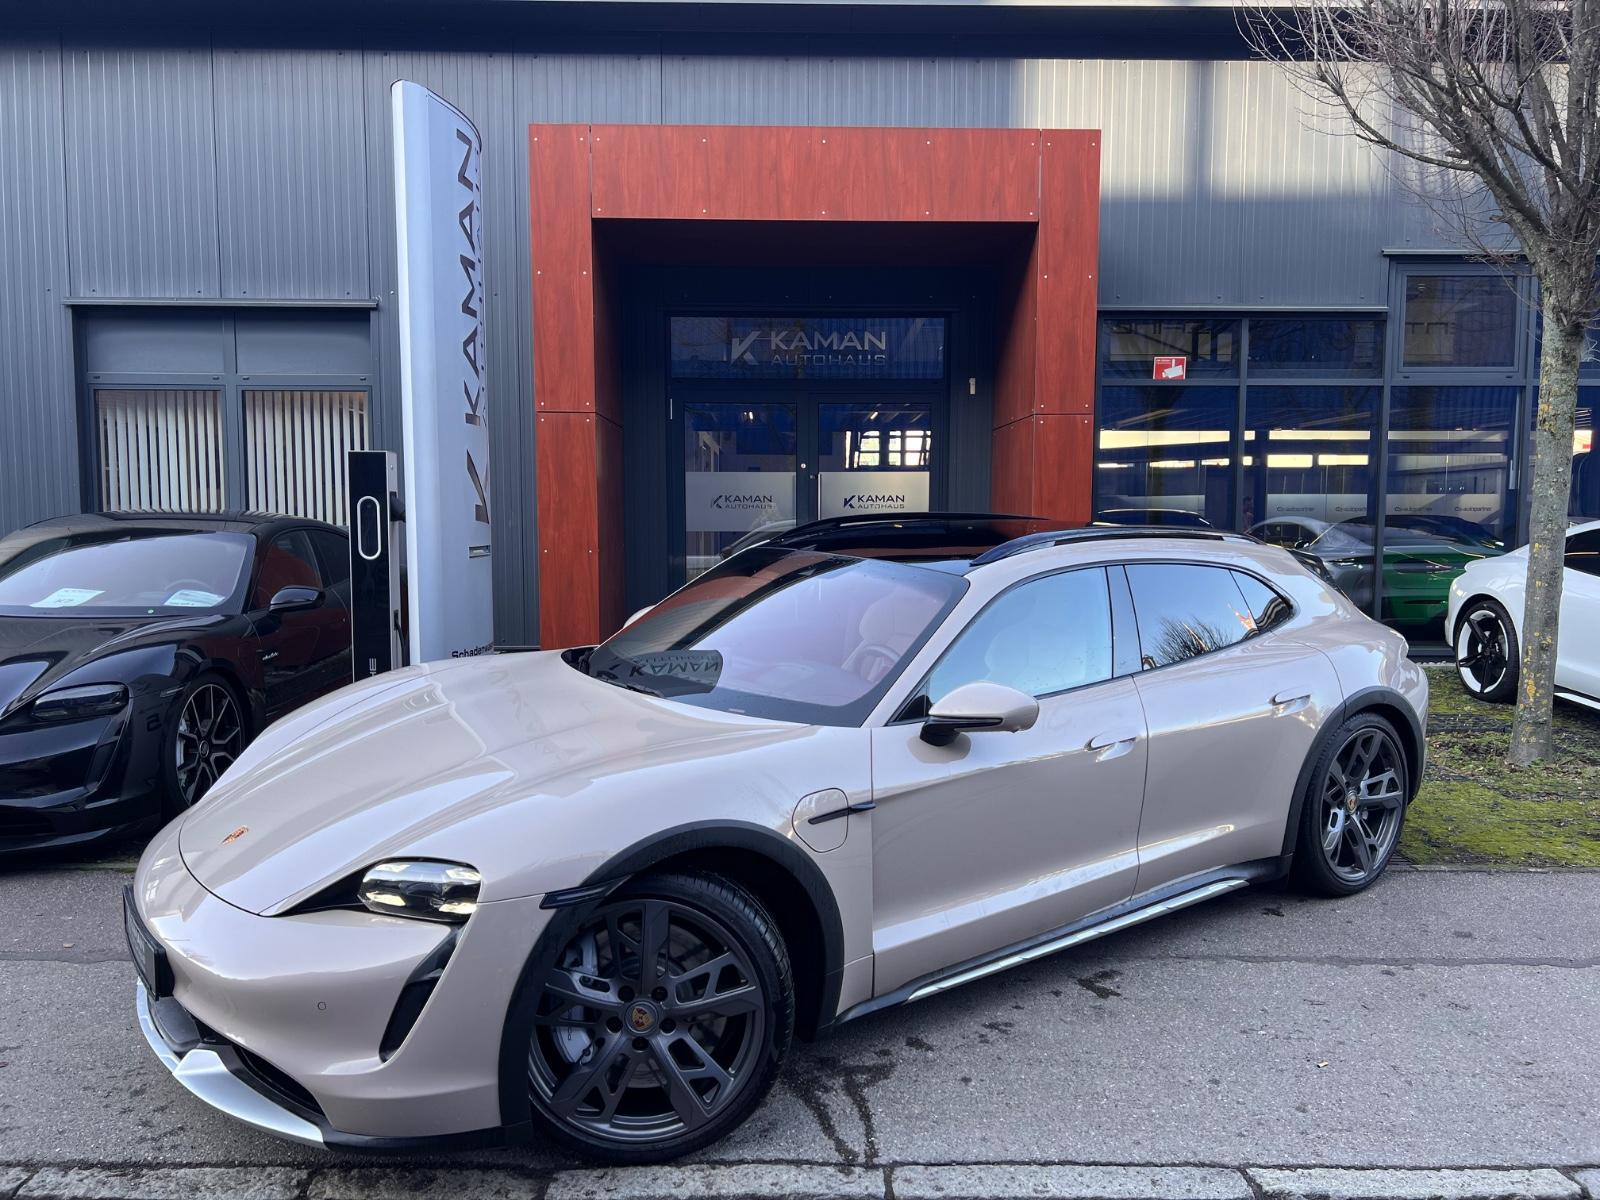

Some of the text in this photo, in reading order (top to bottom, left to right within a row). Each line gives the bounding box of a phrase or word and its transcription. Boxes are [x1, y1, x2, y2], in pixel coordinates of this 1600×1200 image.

[456, 128, 481, 426] KAMAN
[771, 331, 886, 350] KAMAN
[771, 354, 886, 366] AUTOHAUS
[725, 495, 773, 503] KAMAN
[857, 495, 905, 503] KAMAN
